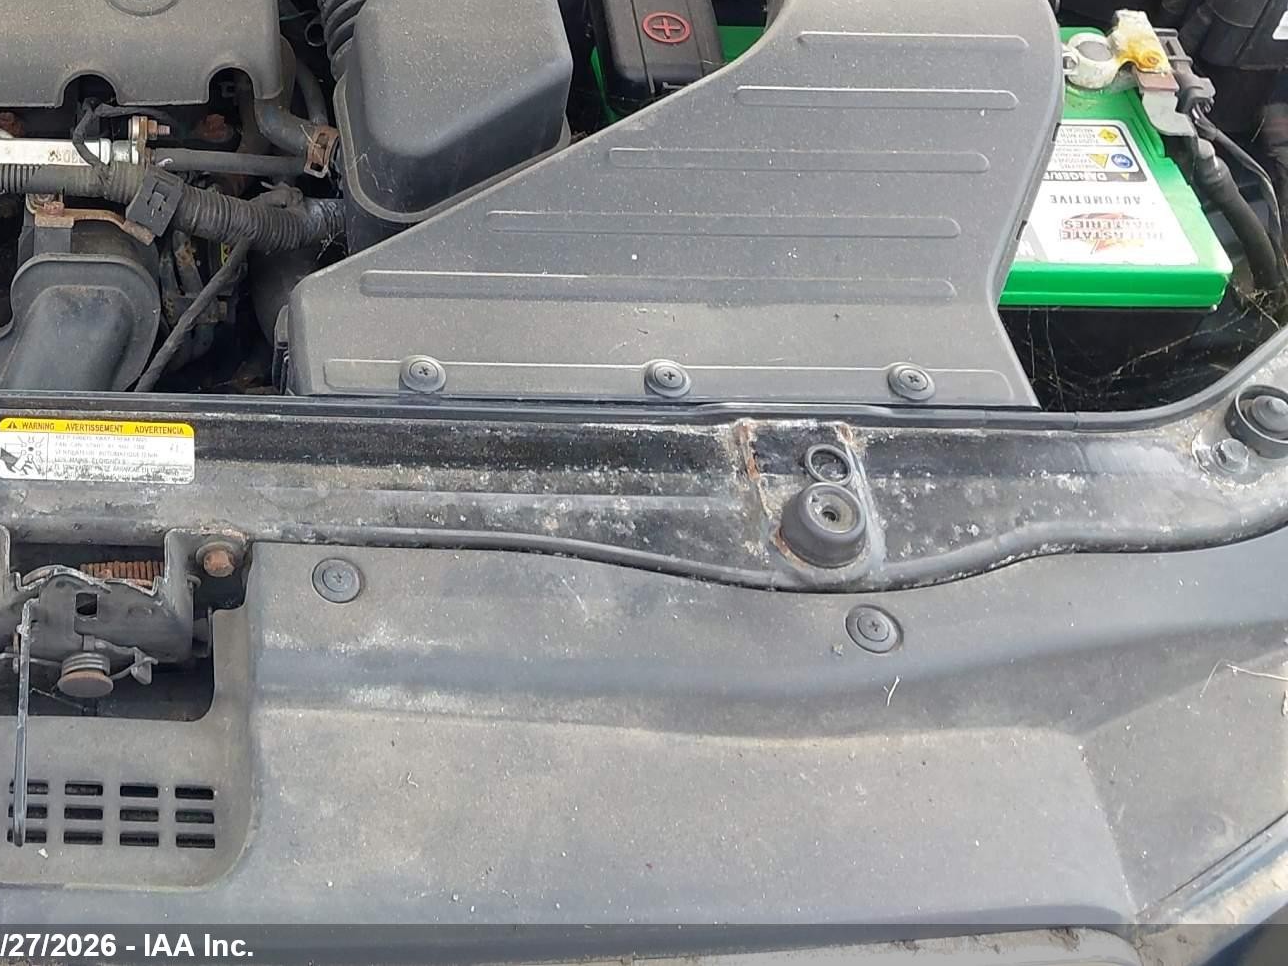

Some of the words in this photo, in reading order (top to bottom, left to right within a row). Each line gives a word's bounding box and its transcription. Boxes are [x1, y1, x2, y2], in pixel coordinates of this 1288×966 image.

[21, 422, 55, 431] WARNING
[65, 423, 124, 433] AVERTISSEMENT
[134, 425, 184, 435] ADVERTENCIA
